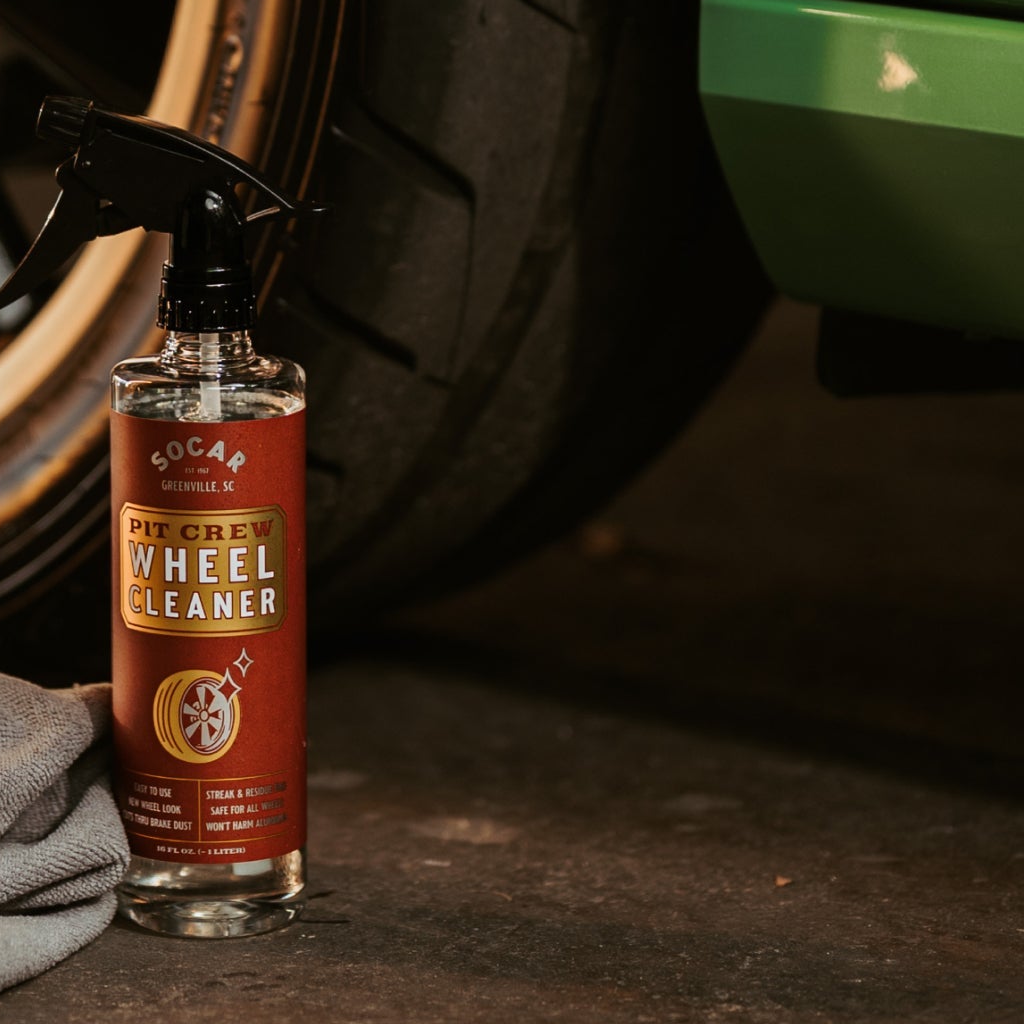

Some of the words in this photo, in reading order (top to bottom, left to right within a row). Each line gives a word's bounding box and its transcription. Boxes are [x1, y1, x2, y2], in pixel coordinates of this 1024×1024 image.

[150, 436, 246, 474] SOCAR
[161, 479, 220, 493] GREENVILLE,
[222, 480, 235, 492] SC
[128, 517, 169, 539] PIT
[180, 519, 274, 541] CREW
[128, 540, 275, 584] WHEEL
[128, 584, 276, 620] CLEANER
[149, 785, 158, 796] TO
[159, 787, 172, 798] USE
[205, 789, 235, 800] STREAK
[236, 788, 244, 799] &
[128, 796, 139, 807] NEW
[141, 800, 161, 812] WHEEL
[162, 804, 182, 815] LOOK
[210, 805, 229, 816] SAFE
[230, 805, 245, 815] FOR
[246, 803, 259, 813] ALL
[134, 813, 149, 826] THRU
[150, 817, 172, 829] BRAKE
[173, 820, 193, 831] DUST
[205, 821, 230, 832] WON'T
[232, 820, 254, 831] HARM
[167, 846, 180, 854] FL
[213, 846, 246, 855] LITER)
